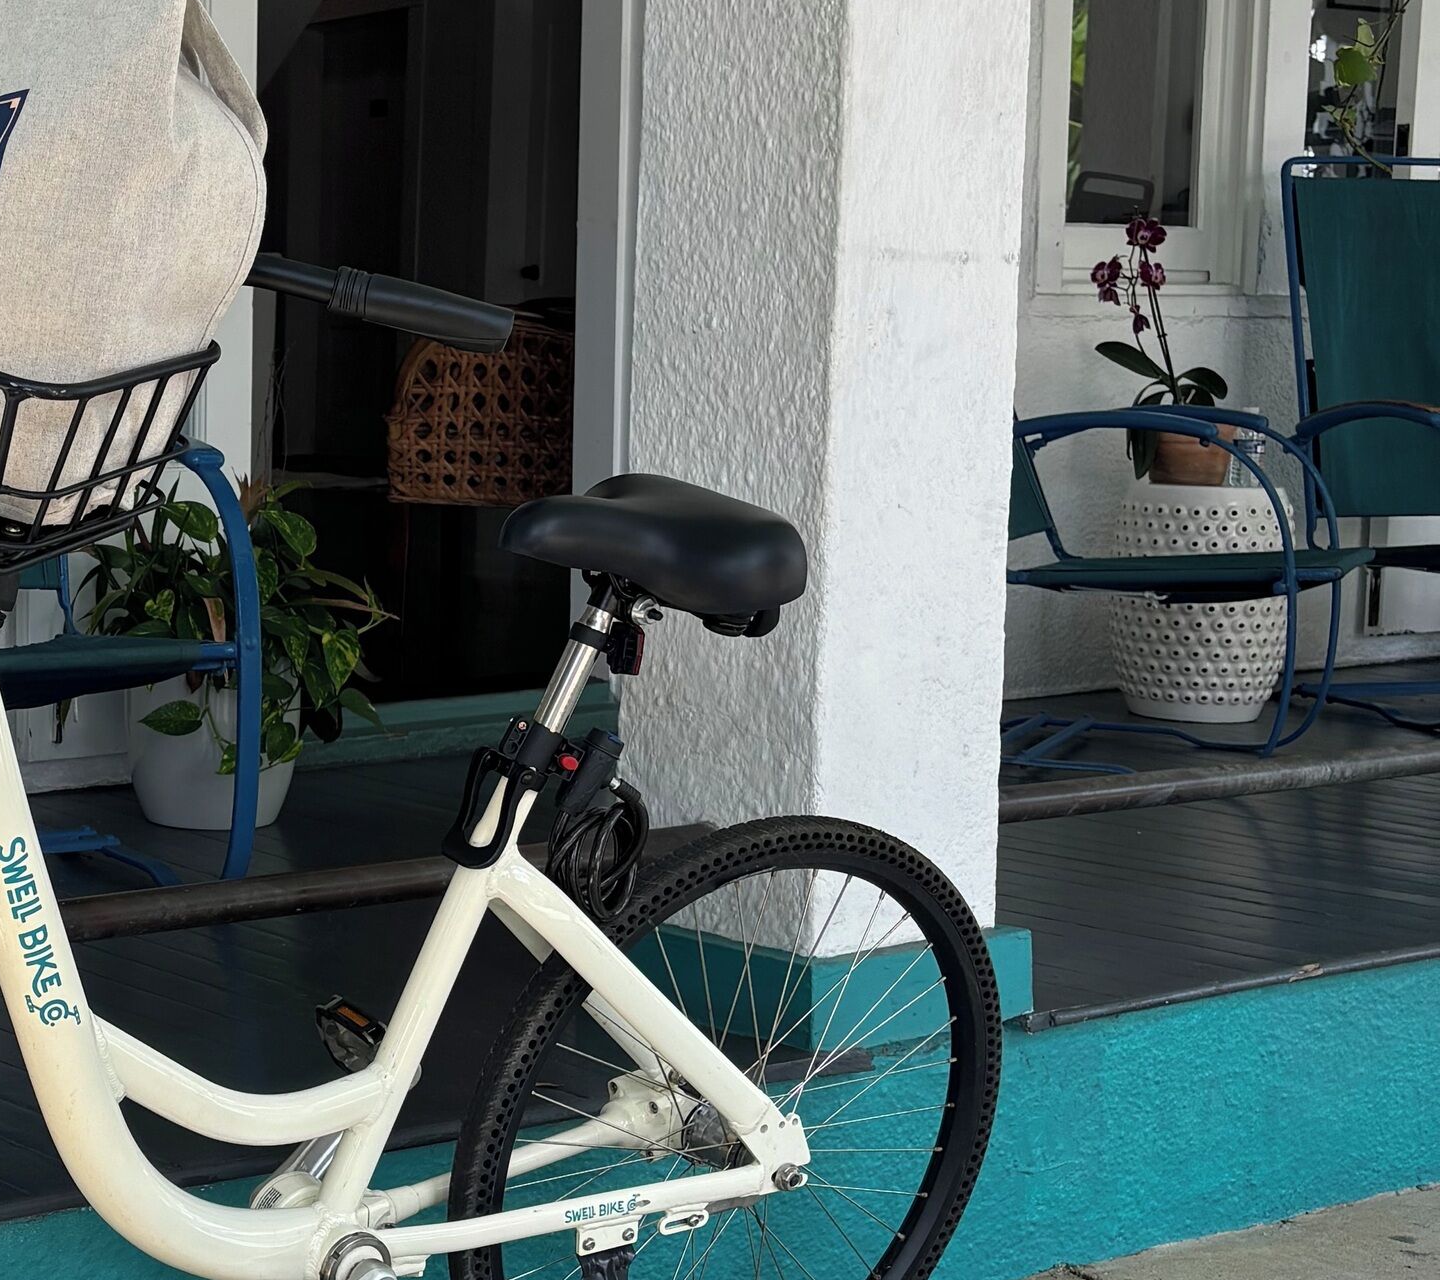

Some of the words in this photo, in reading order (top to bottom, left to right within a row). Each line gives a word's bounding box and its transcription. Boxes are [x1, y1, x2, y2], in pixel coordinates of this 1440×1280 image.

[18, 923, 62, 998] BIKE
[564, 1205, 596, 1224] SWELL
[598, 1200, 625, 1217] BIKE
